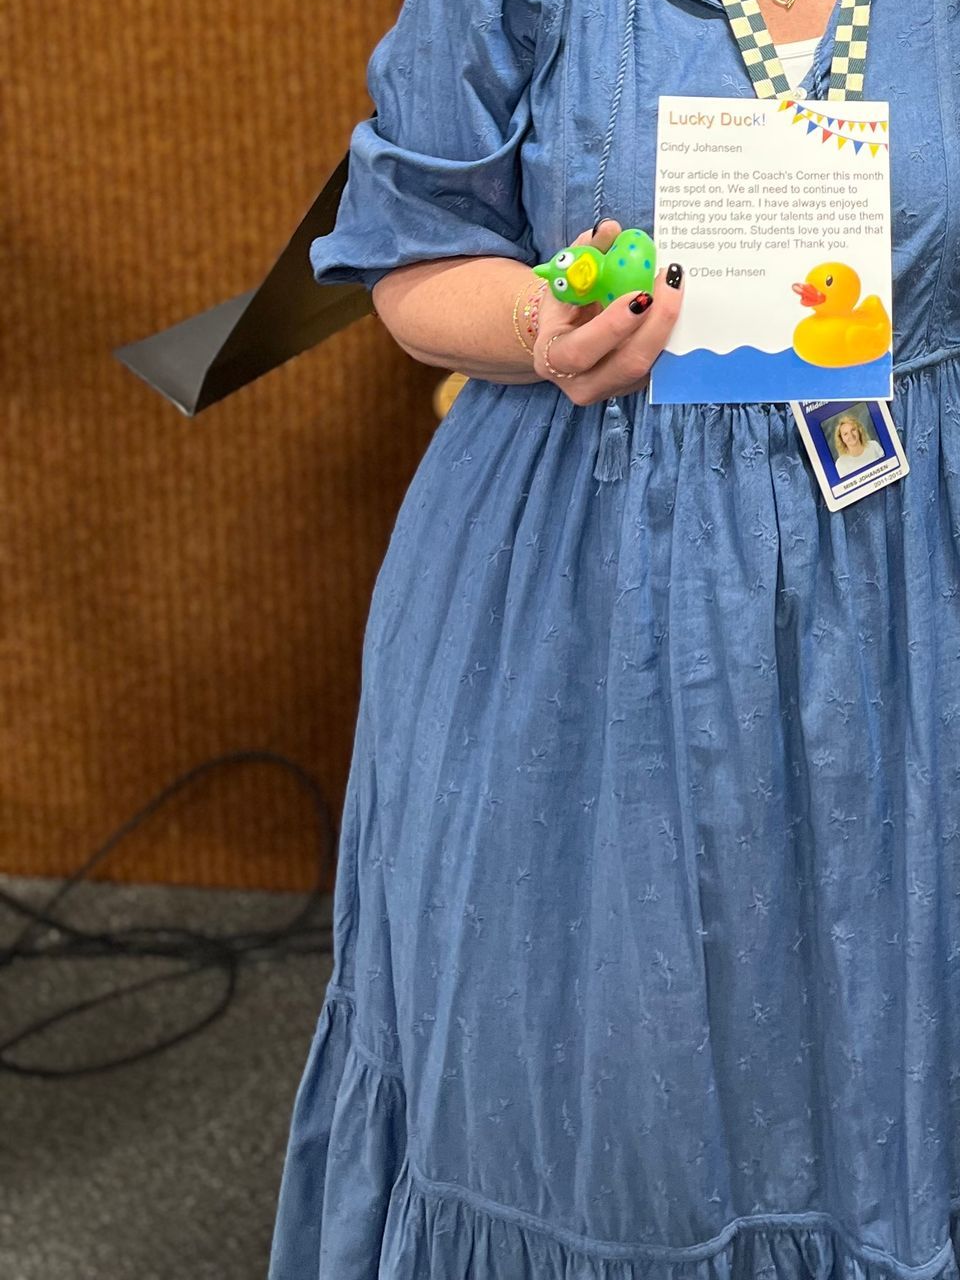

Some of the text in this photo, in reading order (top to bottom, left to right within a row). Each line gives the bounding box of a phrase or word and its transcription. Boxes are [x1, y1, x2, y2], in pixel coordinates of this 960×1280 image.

[669, 111, 767, 129] Lucky Duck!
[660, 141, 743, 154] Cindy Johansen
[659, 169, 884, 180] Your article in the Coach's Corner this month
[659, 183, 858, 196] was spot on. We all need to continue to
[659, 197, 868, 210] improve and learn. I have always enjoyed
[659, 211, 884, 223] watching you take your talents and use them
[658, 225, 884, 237] in the classroom. Students love you and that
[658, 238, 849, 251] is because you truly care! Thank you.
[689, 267, 723, 278] O'Dee
[726, 267, 766, 277] Hansen
[843, 464, 889, 490] MISS JOHANSEN
